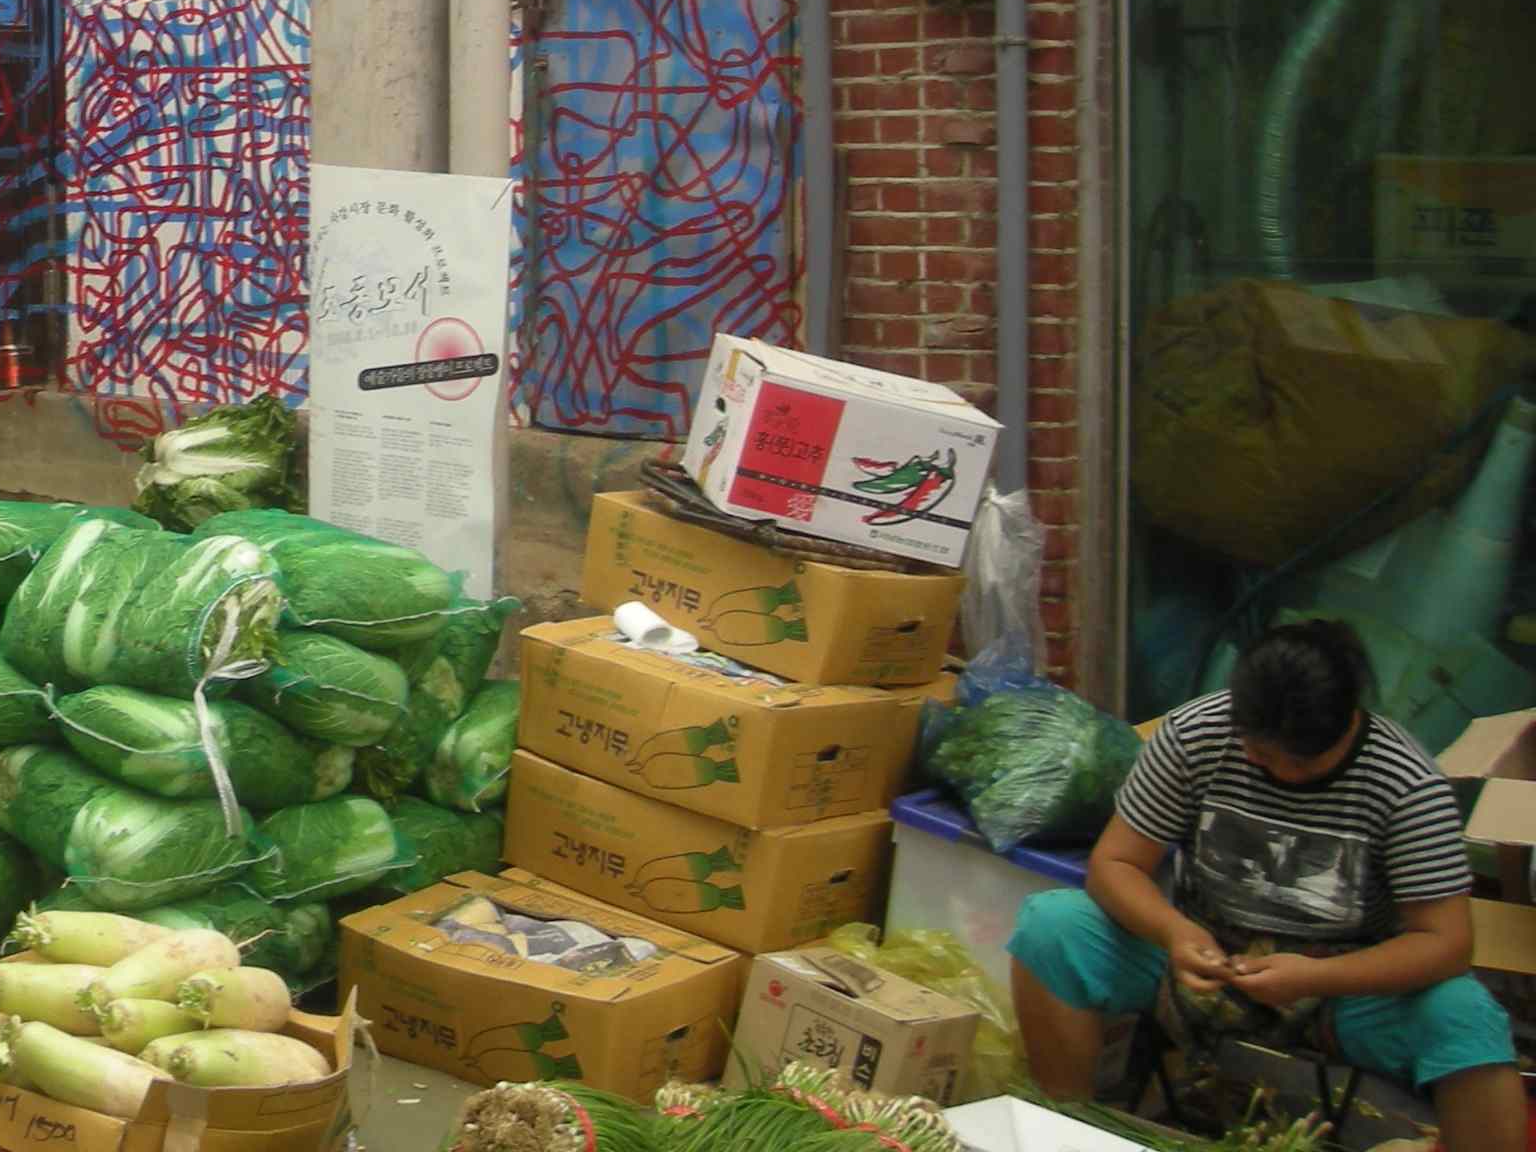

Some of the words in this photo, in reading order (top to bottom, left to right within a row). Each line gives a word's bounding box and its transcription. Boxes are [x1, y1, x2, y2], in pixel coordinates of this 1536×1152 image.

[628, 569, 702, 614] 고냉지무
[555, 709, 629, 756] 고냉지무
[551, 831, 625, 879] 고냉지무
[381, 1004, 458, 1054] 고냉지무
